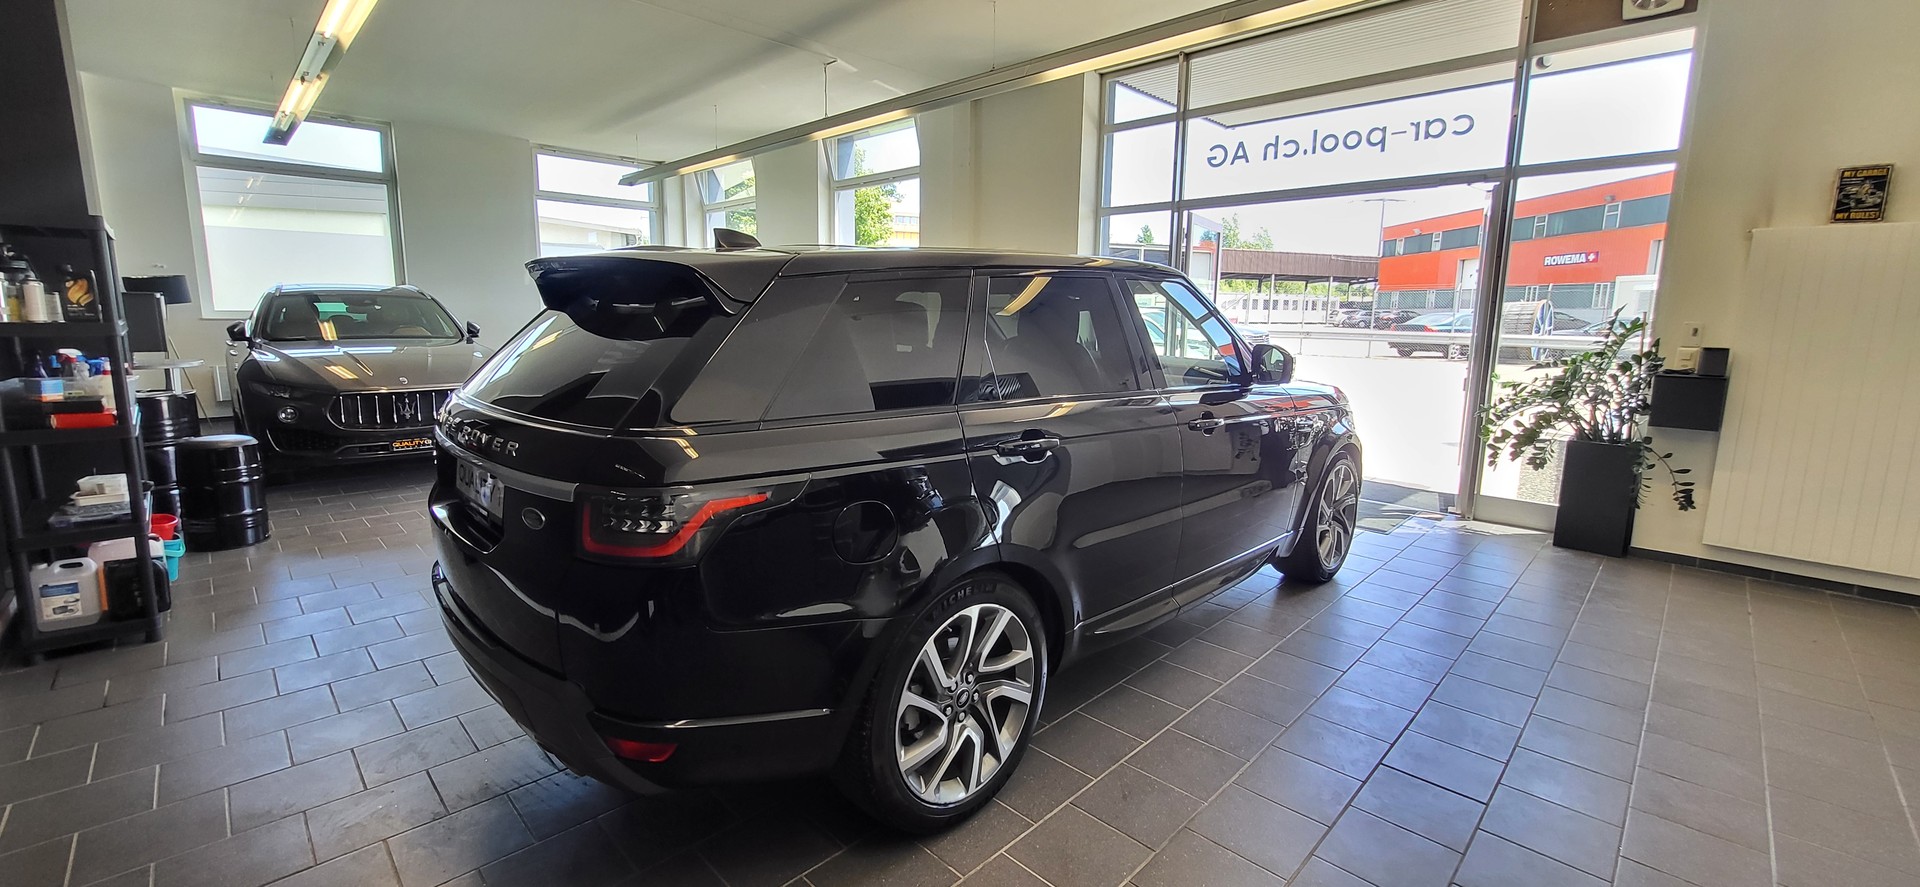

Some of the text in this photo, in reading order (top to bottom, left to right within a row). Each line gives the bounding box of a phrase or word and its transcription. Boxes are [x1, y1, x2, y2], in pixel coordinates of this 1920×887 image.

[1857, 168, 1888, 177] GARAGE
[1544, 253, 1586, 266] ROWEMA
[461, 425, 519, 457] ROVER
